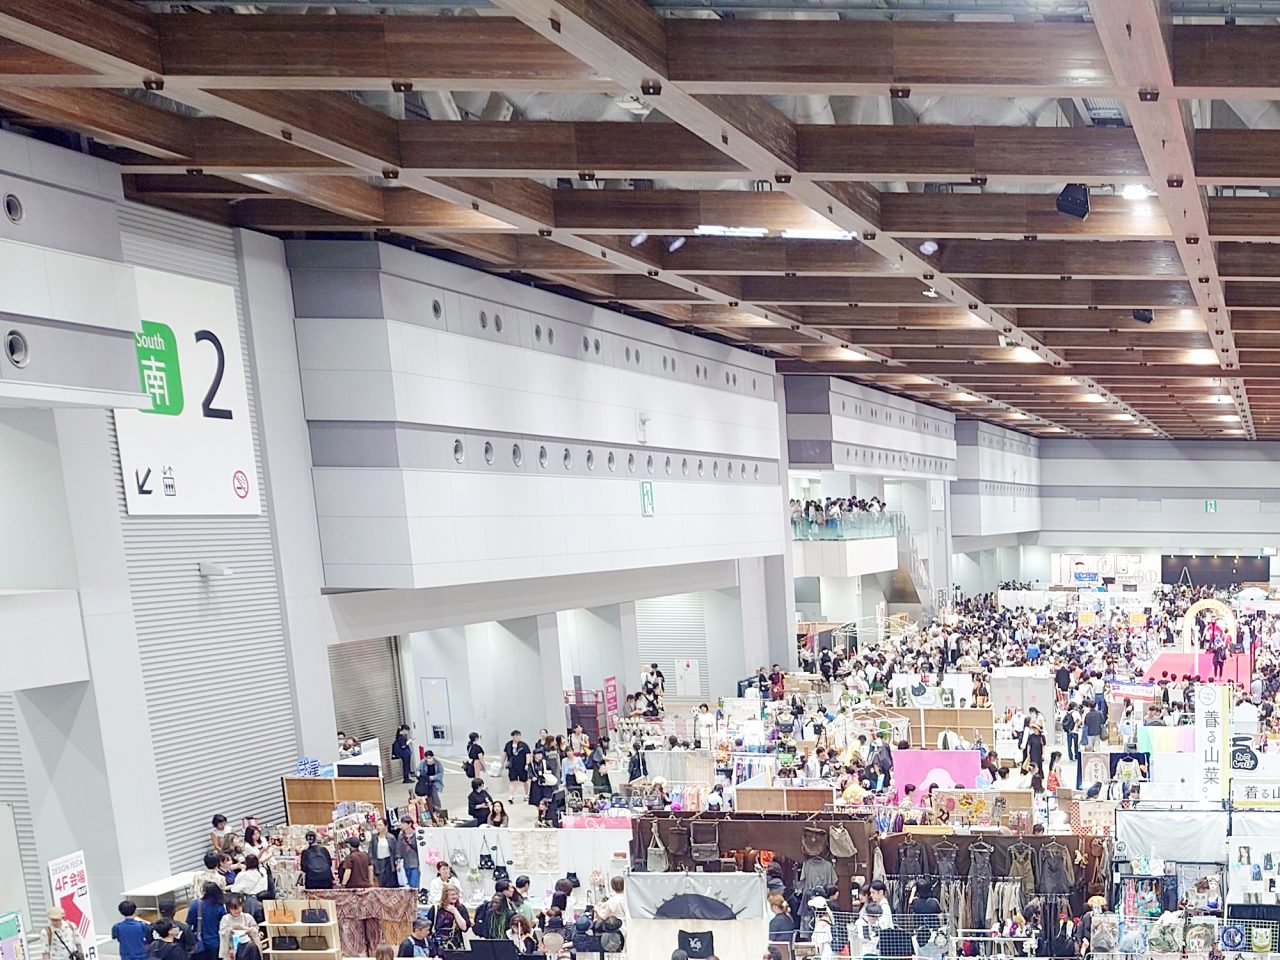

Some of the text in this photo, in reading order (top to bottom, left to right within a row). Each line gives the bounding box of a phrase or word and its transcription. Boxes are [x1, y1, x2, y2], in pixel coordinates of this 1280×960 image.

[136, 331, 165, 351] South
[141, 329, 233, 420] 南 2
